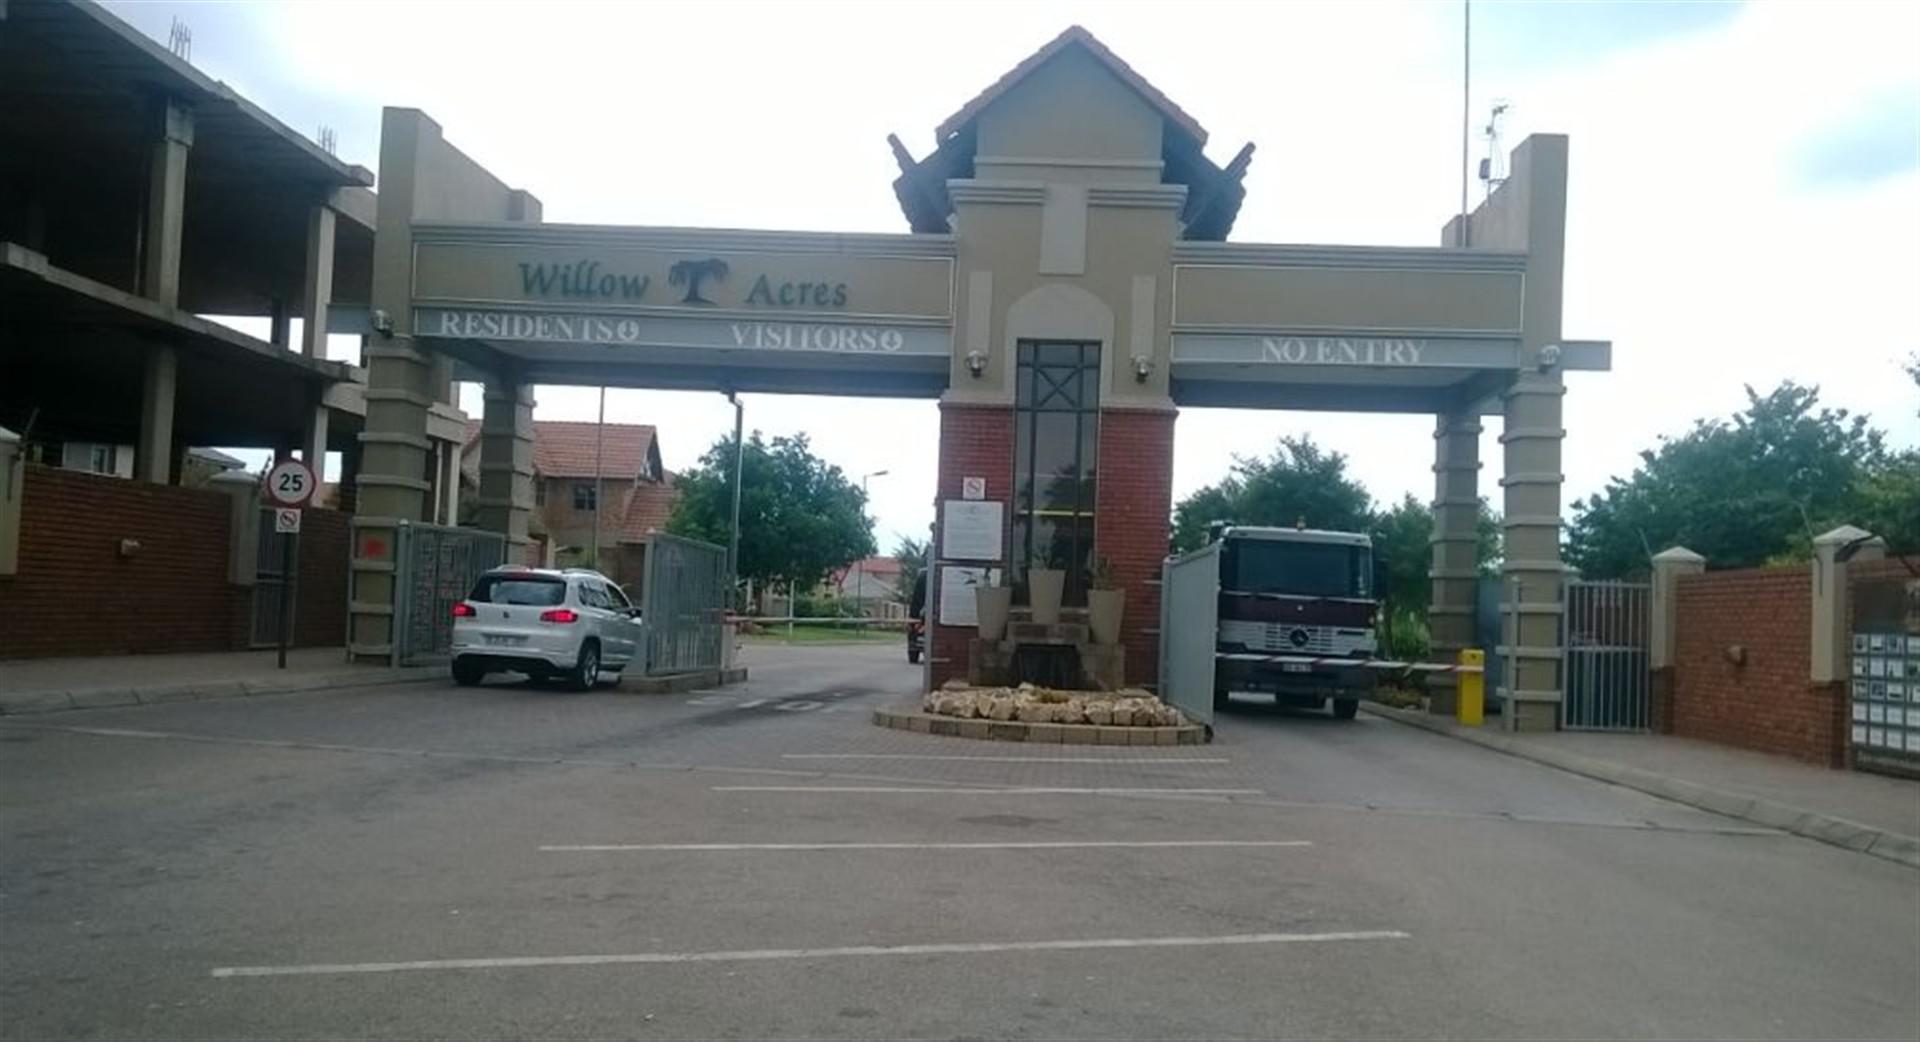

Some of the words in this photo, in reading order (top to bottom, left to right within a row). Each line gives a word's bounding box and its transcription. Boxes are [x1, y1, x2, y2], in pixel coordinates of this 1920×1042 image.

[518, 259, 649, 299] Willow
[746, 273, 848, 307] Acres
[440, 311, 614, 341] RESIDENTS
[731, 324, 877, 350] VISITORS
[1261, 337, 1307, 363] NO
[1317, 339, 1427, 364] ENTRY
[279, 472, 303, 492] 25
